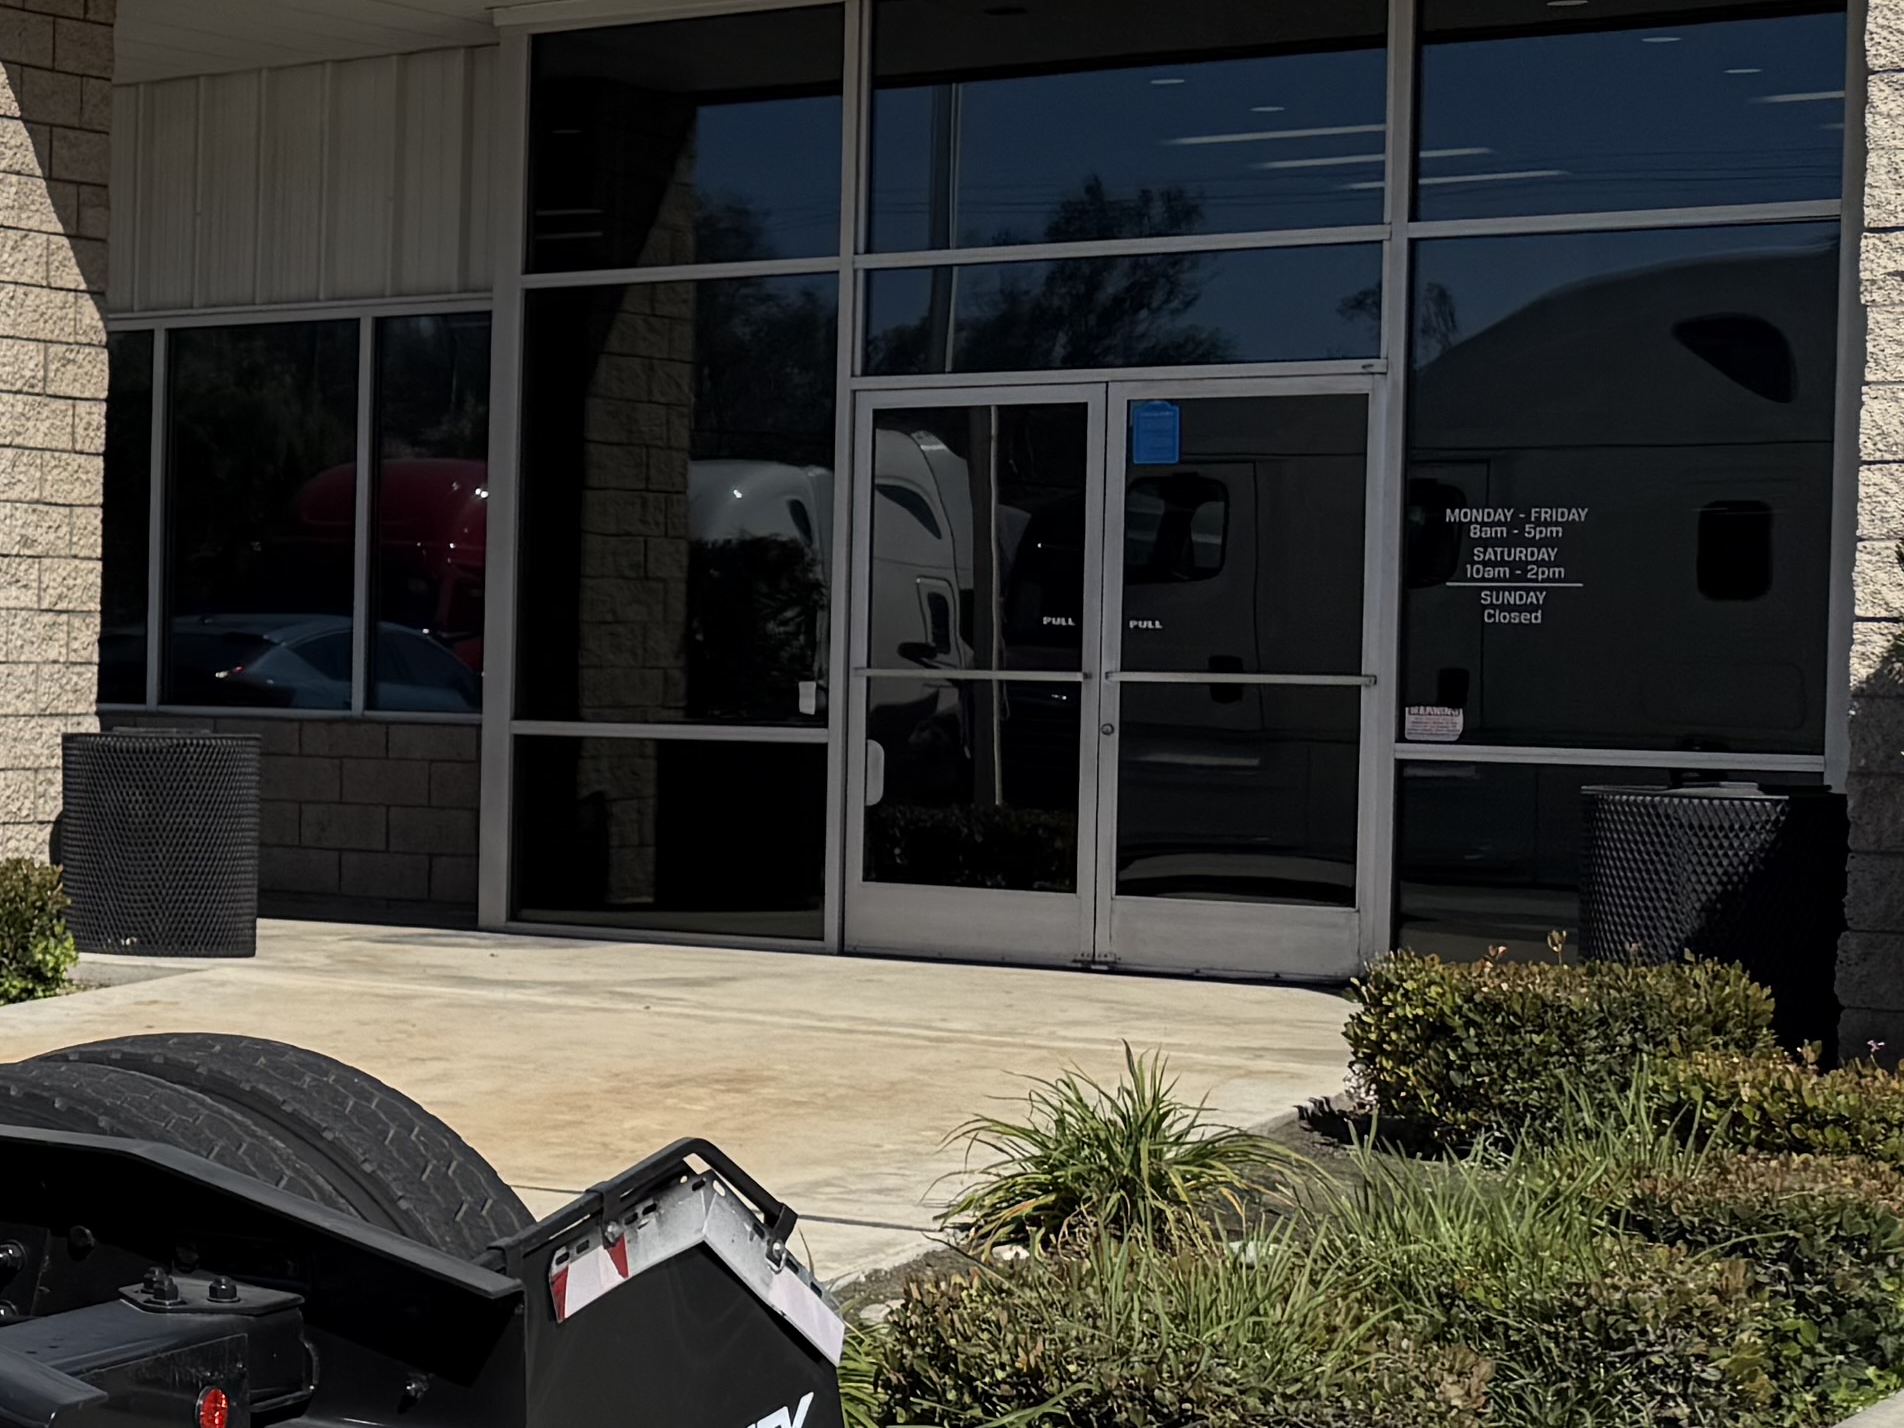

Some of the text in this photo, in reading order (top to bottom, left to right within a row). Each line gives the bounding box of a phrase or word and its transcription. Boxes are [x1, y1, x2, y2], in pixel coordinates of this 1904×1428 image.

[1445, 508, 1514, 523] MONDAY
[1530, 507, 1589, 522] FRIDAY
[1469, 524, 1507, 539] 8am
[1524, 524, 1563, 541] 5pm
[1473, 547, 1558, 562] SATURDAY
[1466, 564, 1510, 579] 10am
[1526, 565, 1565, 582] 2pm
[1480, 590, 1547, 605] SUNDAY
[1042, 616, 1076, 626] PULL
[1483, 608, 1542, 624] Closed
[1129, 619, 1163, 629] PULL
